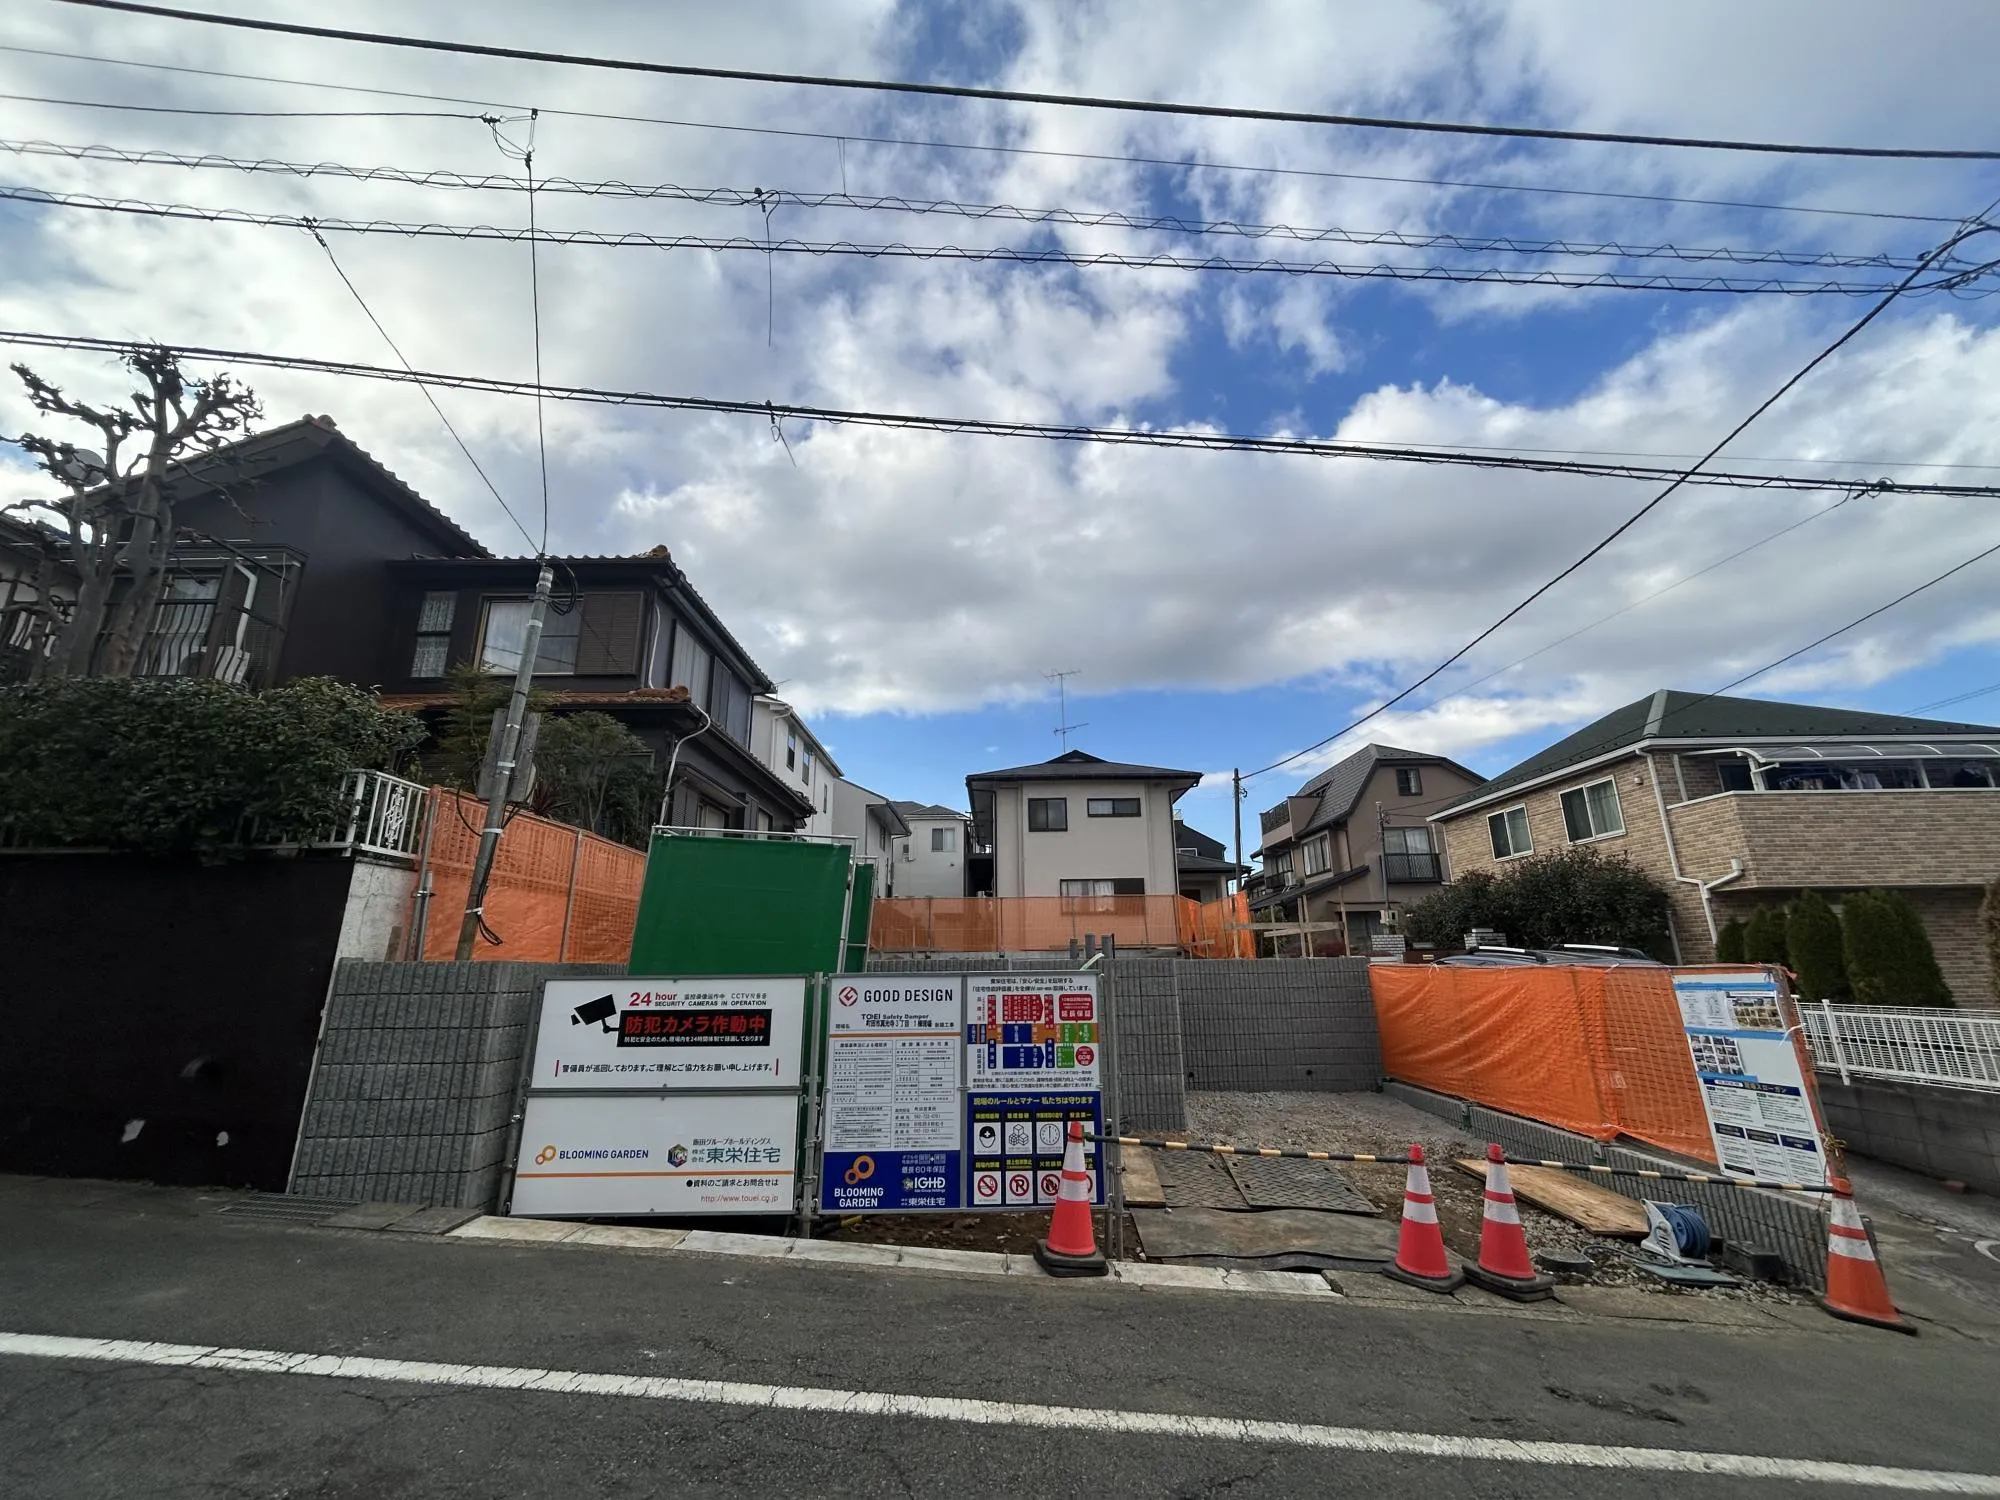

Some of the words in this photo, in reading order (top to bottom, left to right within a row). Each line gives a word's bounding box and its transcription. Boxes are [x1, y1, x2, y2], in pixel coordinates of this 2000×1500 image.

[629, 992, 652, 1006] 24
[864, 990, 900, 1002] GOOD
[905, 989, 953, 1001] DESIGN
[625, 1015, 766, 1034] 防犯カメラ作動中
[559, 1151, 608, 1160] BLOOMING
[611, 1150, 649, 1159] GARDEN
[706, 1147, 781, 1163] 東栄住宅
[834, 1188, 884, 1197] BLOOMING
[839, 1198, 877, 1207] GARDEN
[908, 1198, 945, 1206] 東栄住宅
